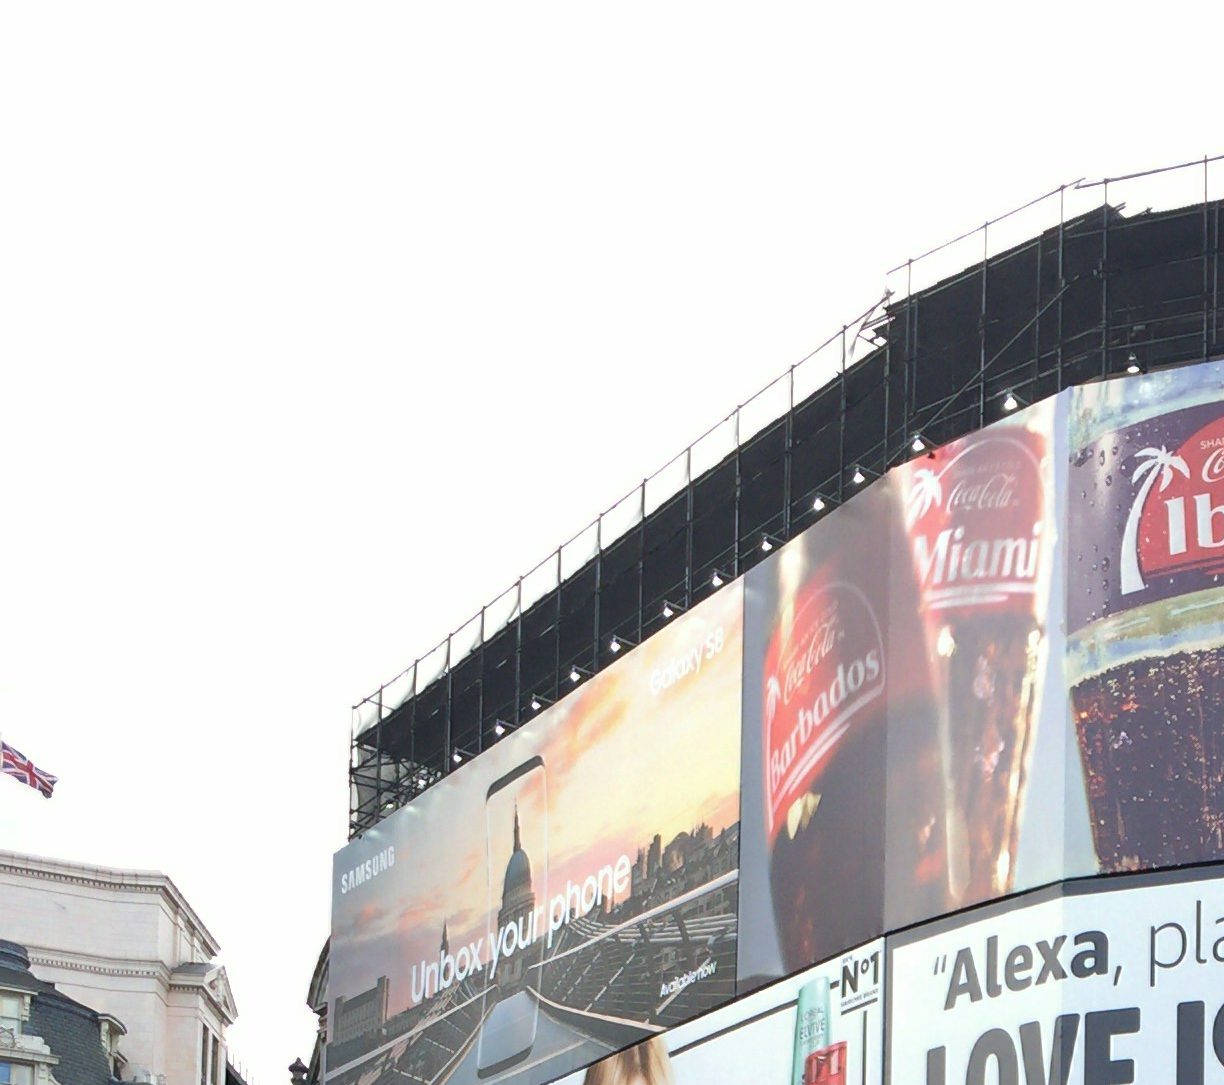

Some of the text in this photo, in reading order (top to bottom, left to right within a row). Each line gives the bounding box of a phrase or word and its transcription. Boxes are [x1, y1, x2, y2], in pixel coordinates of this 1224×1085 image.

[914, 520, 1043, 586] Miami
[651, 627, 725, 696] Galaxy S8
[772, 648, 881, 791] Barbados
[341, 845, 396, 894] SAMSUNG
[411, 854, 632, 1003] Unbox your phone
